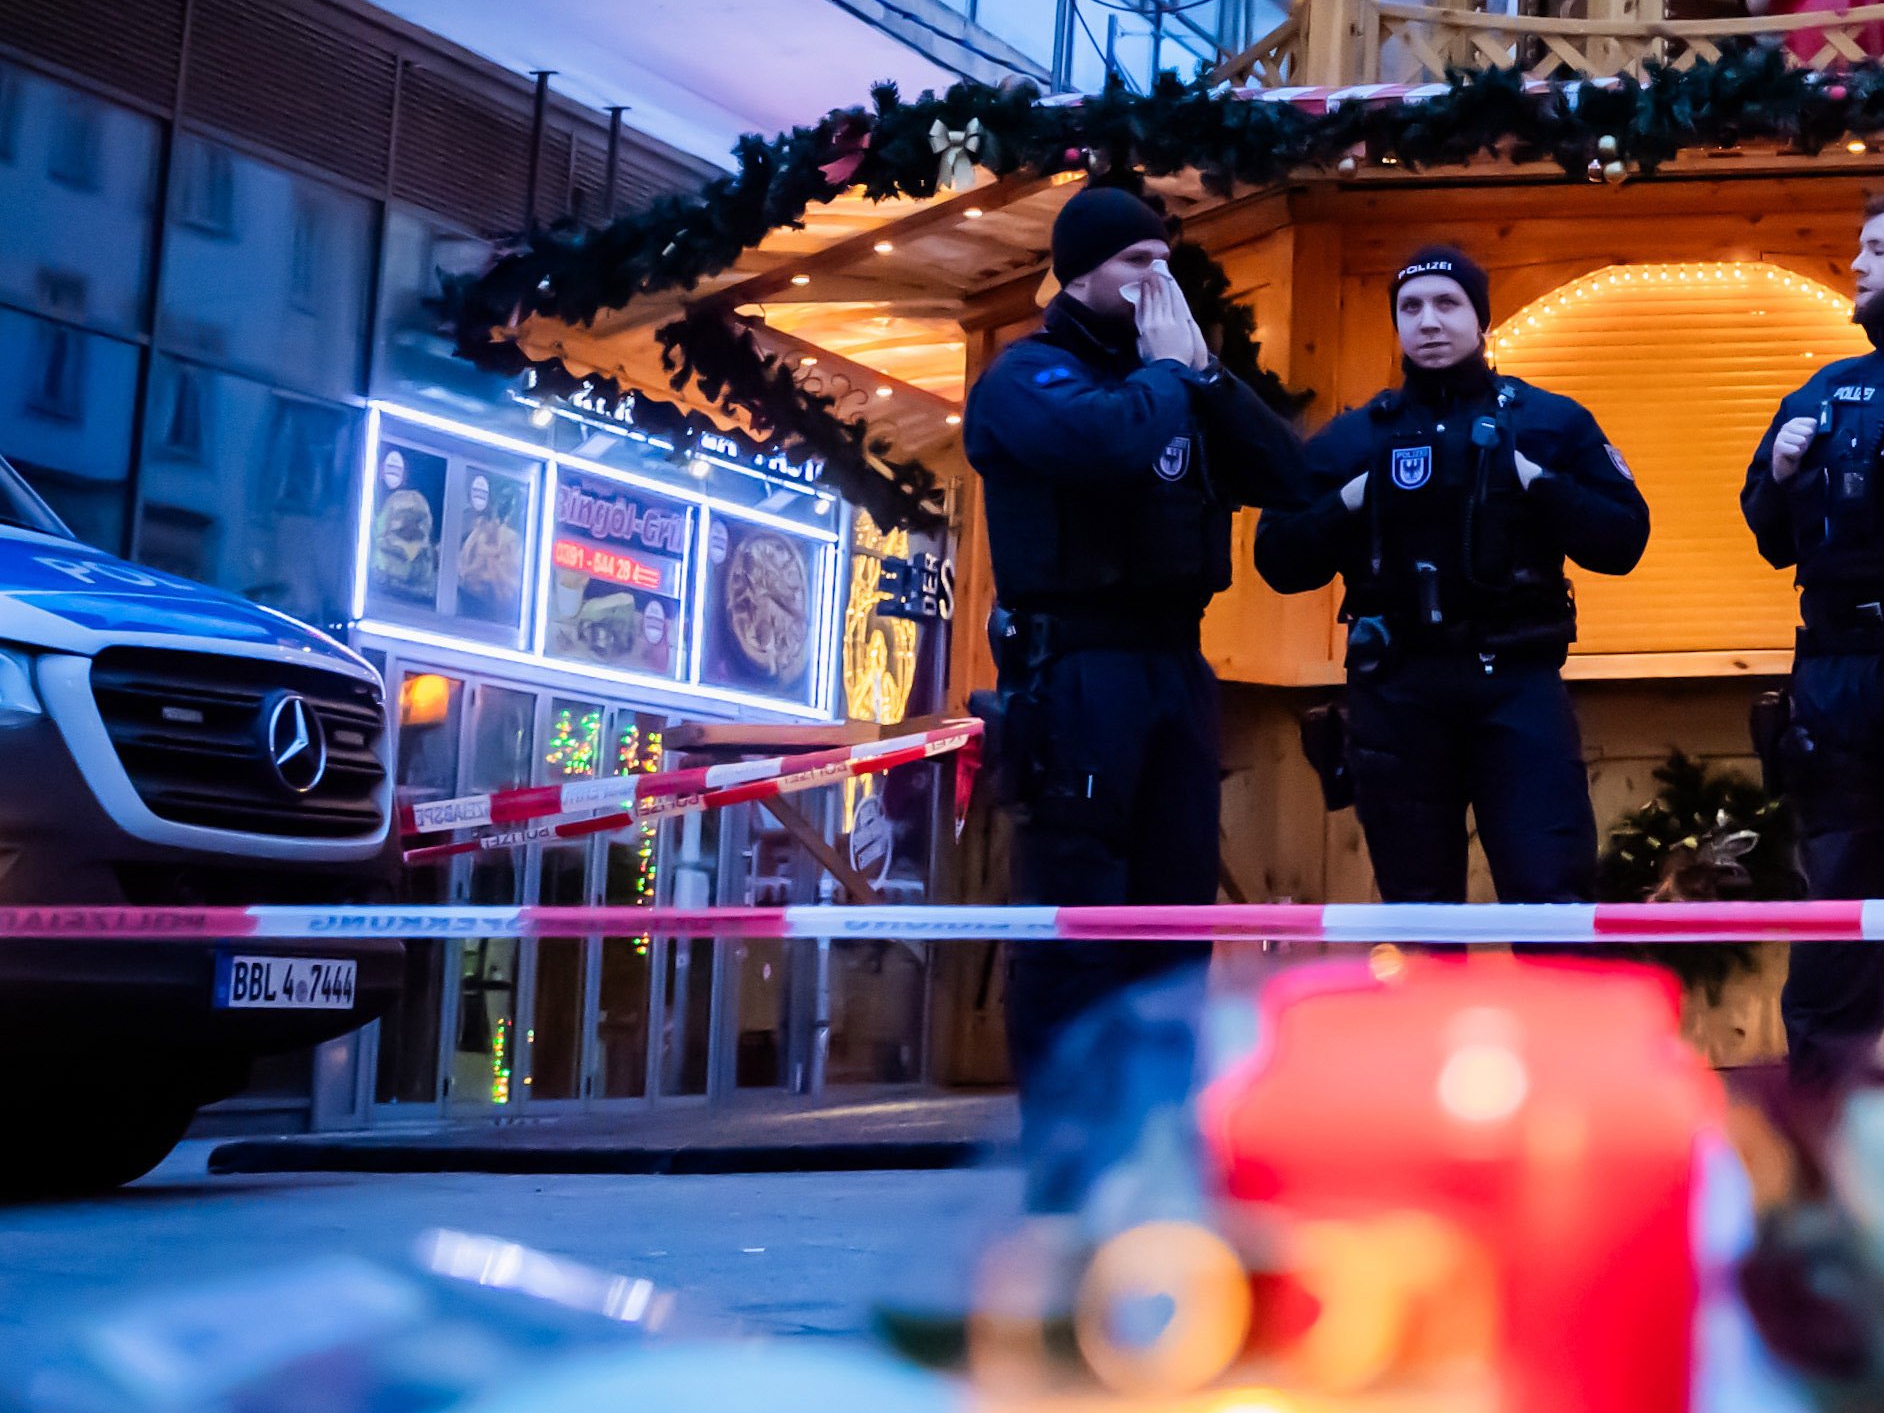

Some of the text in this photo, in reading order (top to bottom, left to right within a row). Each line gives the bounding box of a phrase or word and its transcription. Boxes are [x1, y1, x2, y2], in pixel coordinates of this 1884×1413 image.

[1398, 261, 1452, 280] POLIZEI
[233, 961, 277, 1002] BBL
[310, 963, 353, 1004] 7444
